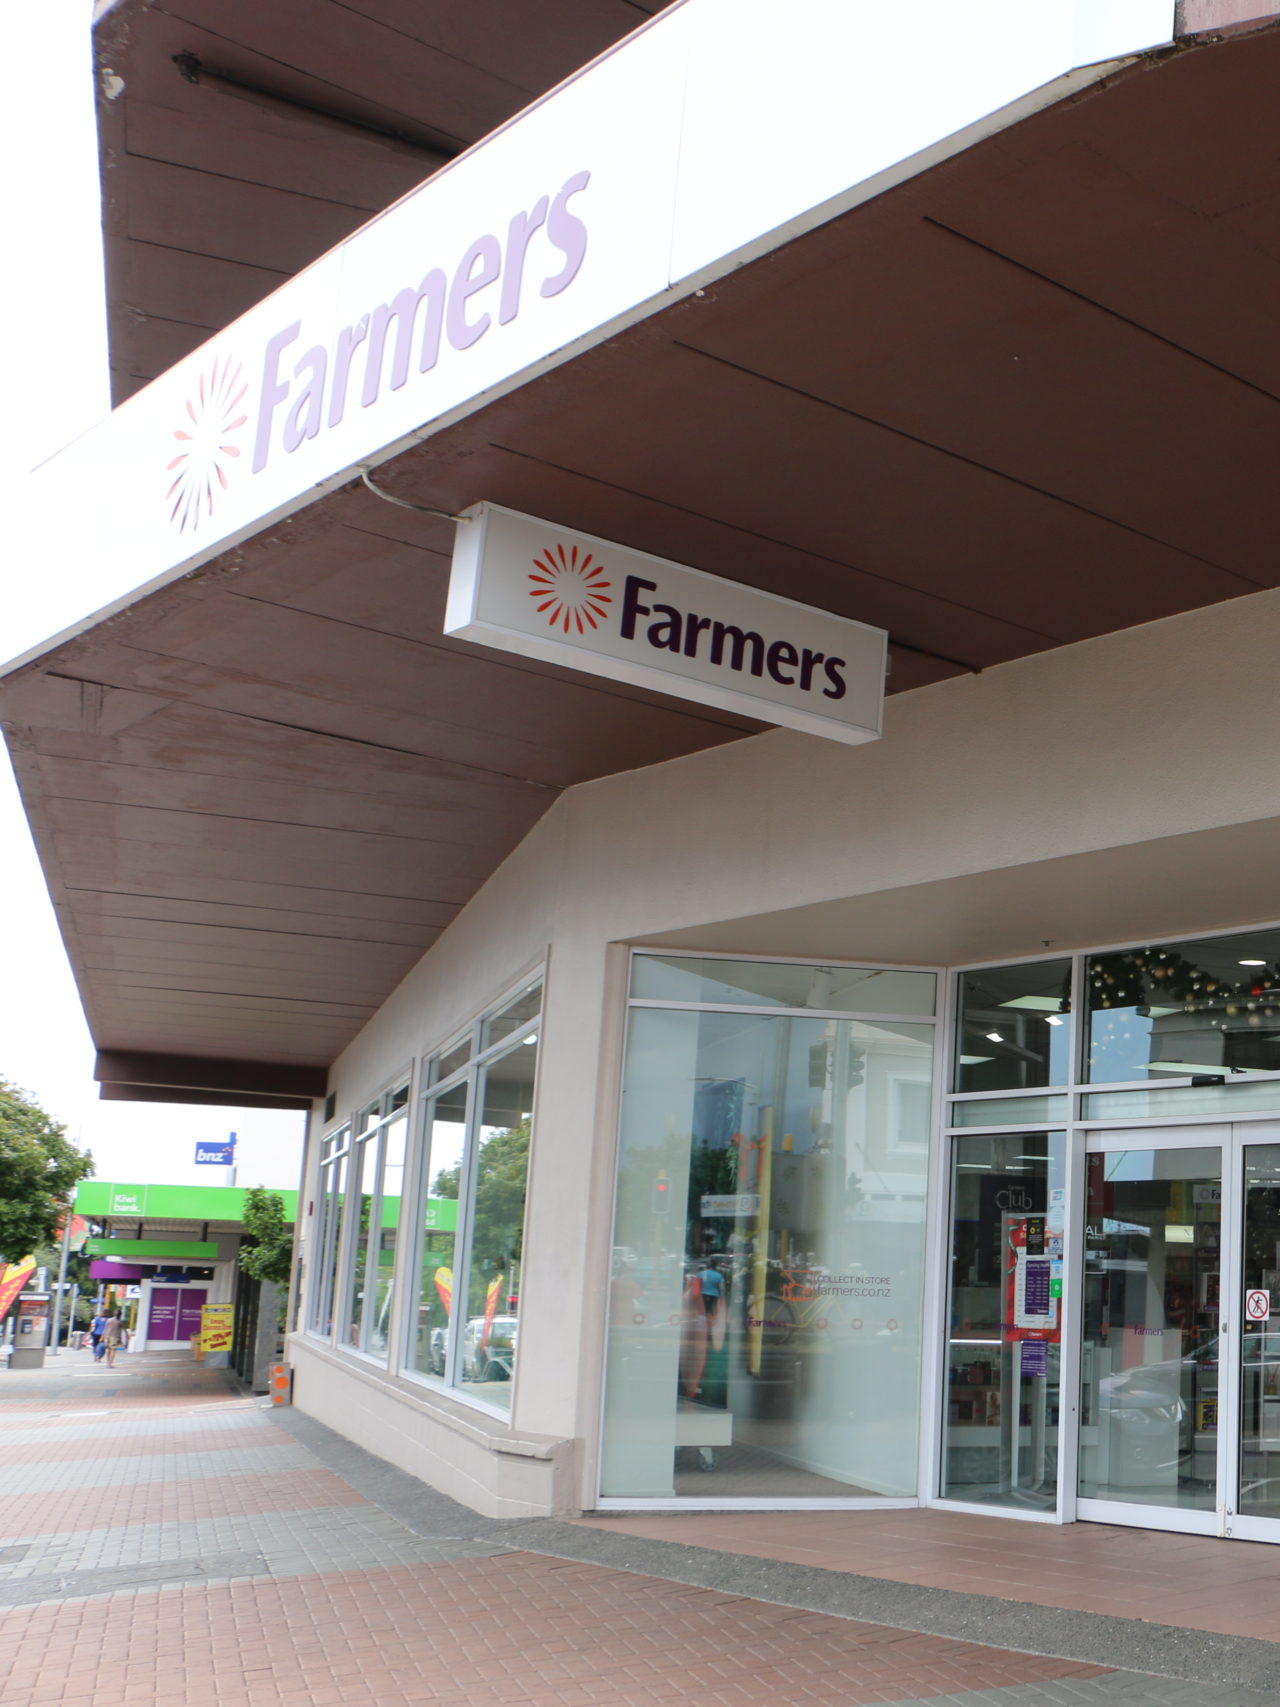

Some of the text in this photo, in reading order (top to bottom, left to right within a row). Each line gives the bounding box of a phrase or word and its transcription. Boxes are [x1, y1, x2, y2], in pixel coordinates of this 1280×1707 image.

[251, 170, 592, 474] Farmers
[620, 575, 847, 700] Farmers
[196, 1149, 224, 1162] bnz
[114, 1194, 137, 1203] Kiwi
[995, 1190, 1033, 1210] Club
[816, 1275, 854, 1284] COLLECT
[864, 1276, 891, 1285] STORE
[816, 1285, 891, 1297] farmers.co.nz
[1134, 1325, 1164, 1337] Farmers
